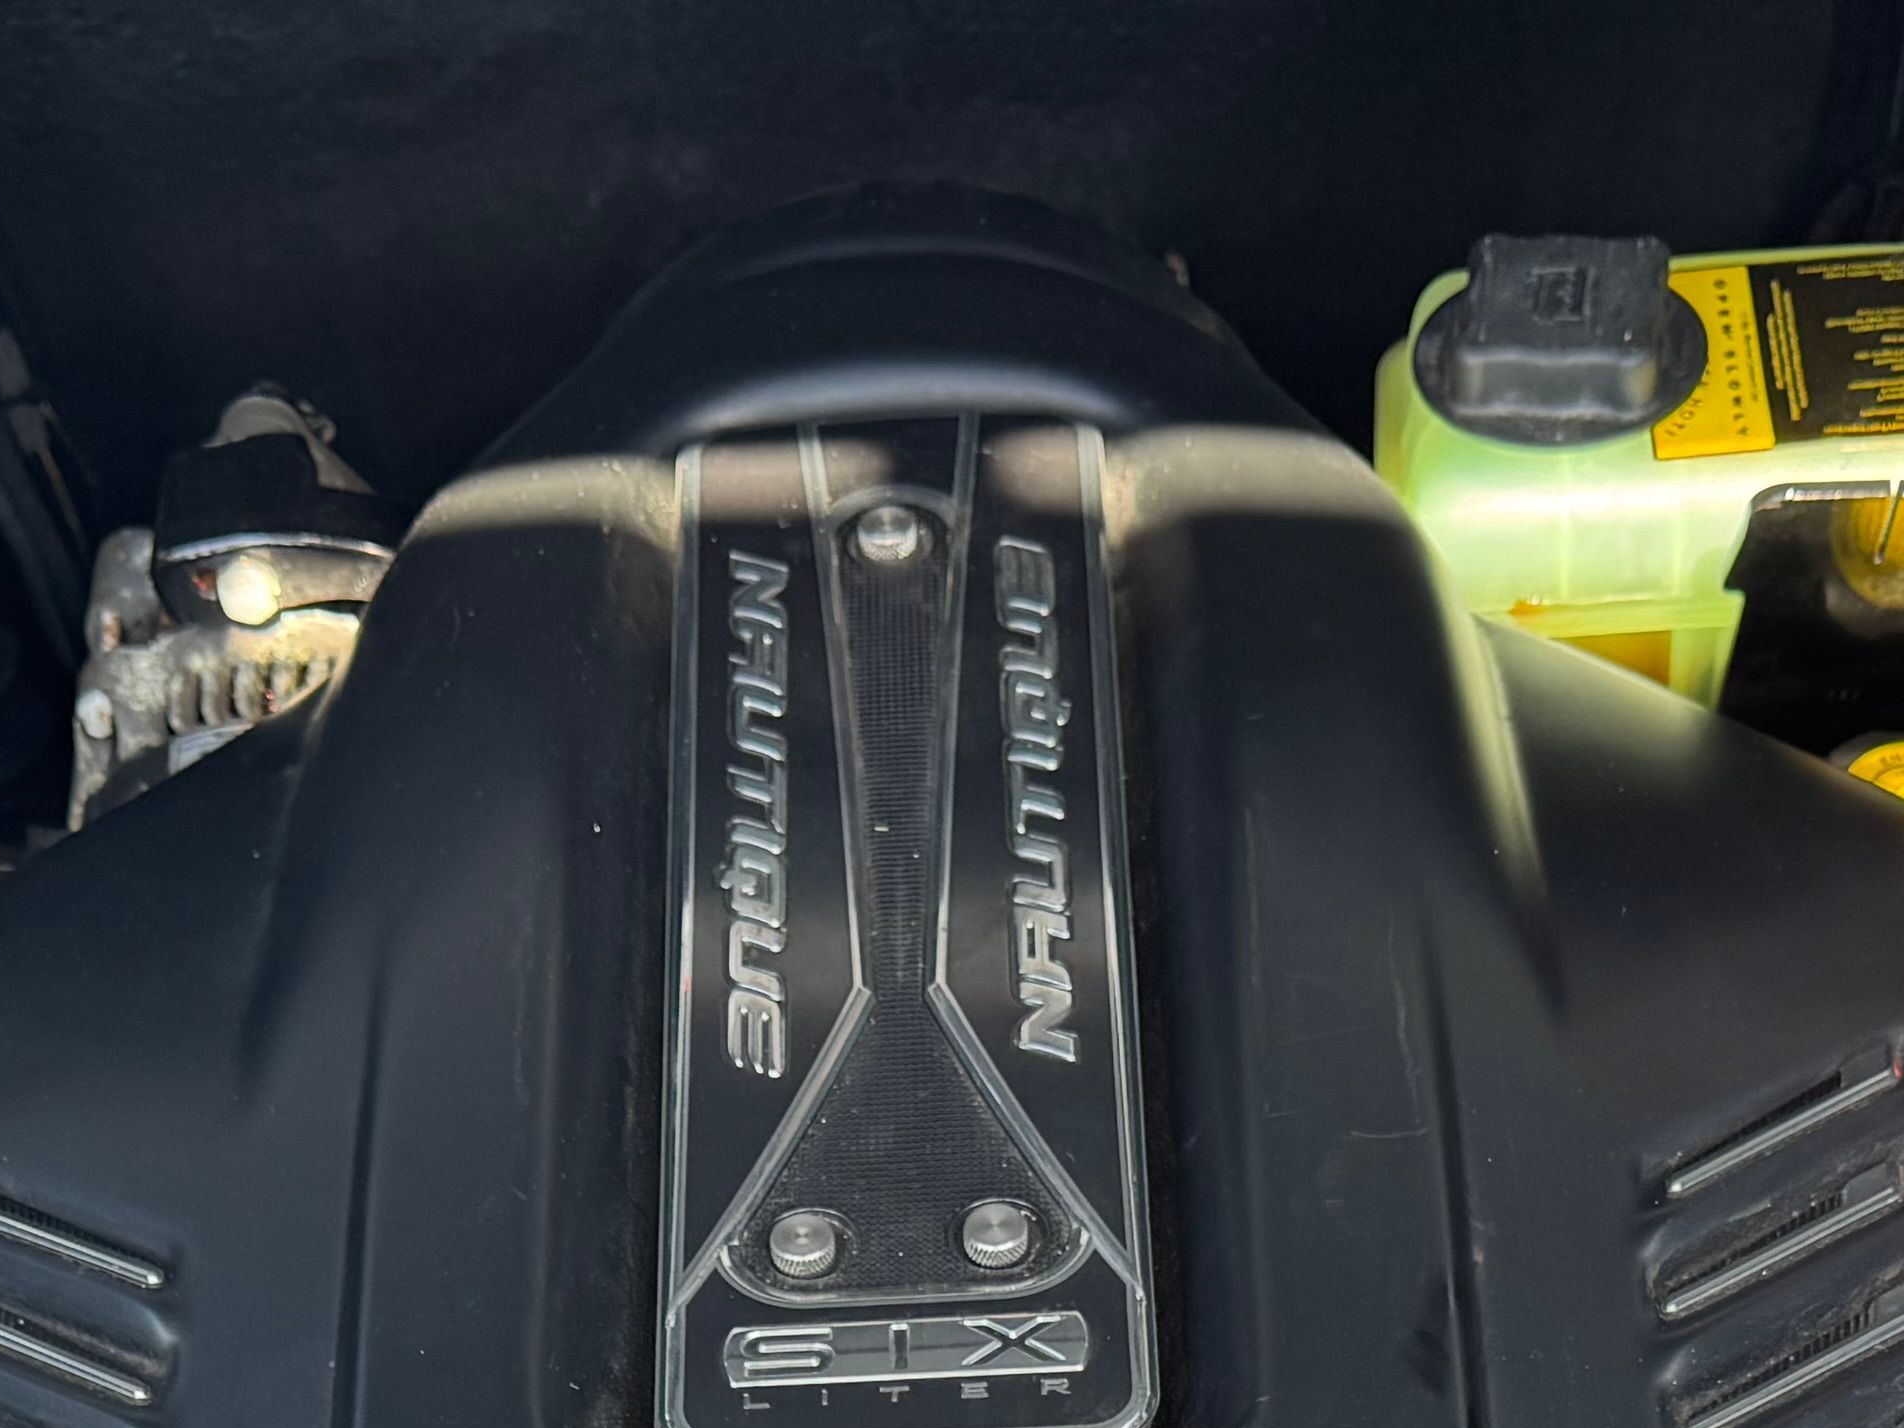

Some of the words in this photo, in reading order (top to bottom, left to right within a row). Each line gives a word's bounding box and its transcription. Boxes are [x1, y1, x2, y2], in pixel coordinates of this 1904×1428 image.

[725, 548, 792, 1080] NAUTIQUE
[994, 535, 1081, 1064] NAUTIQUE
[736, 1313, 1068, 1379] SIX
[743, 1378, 1072, 1411] LITER
